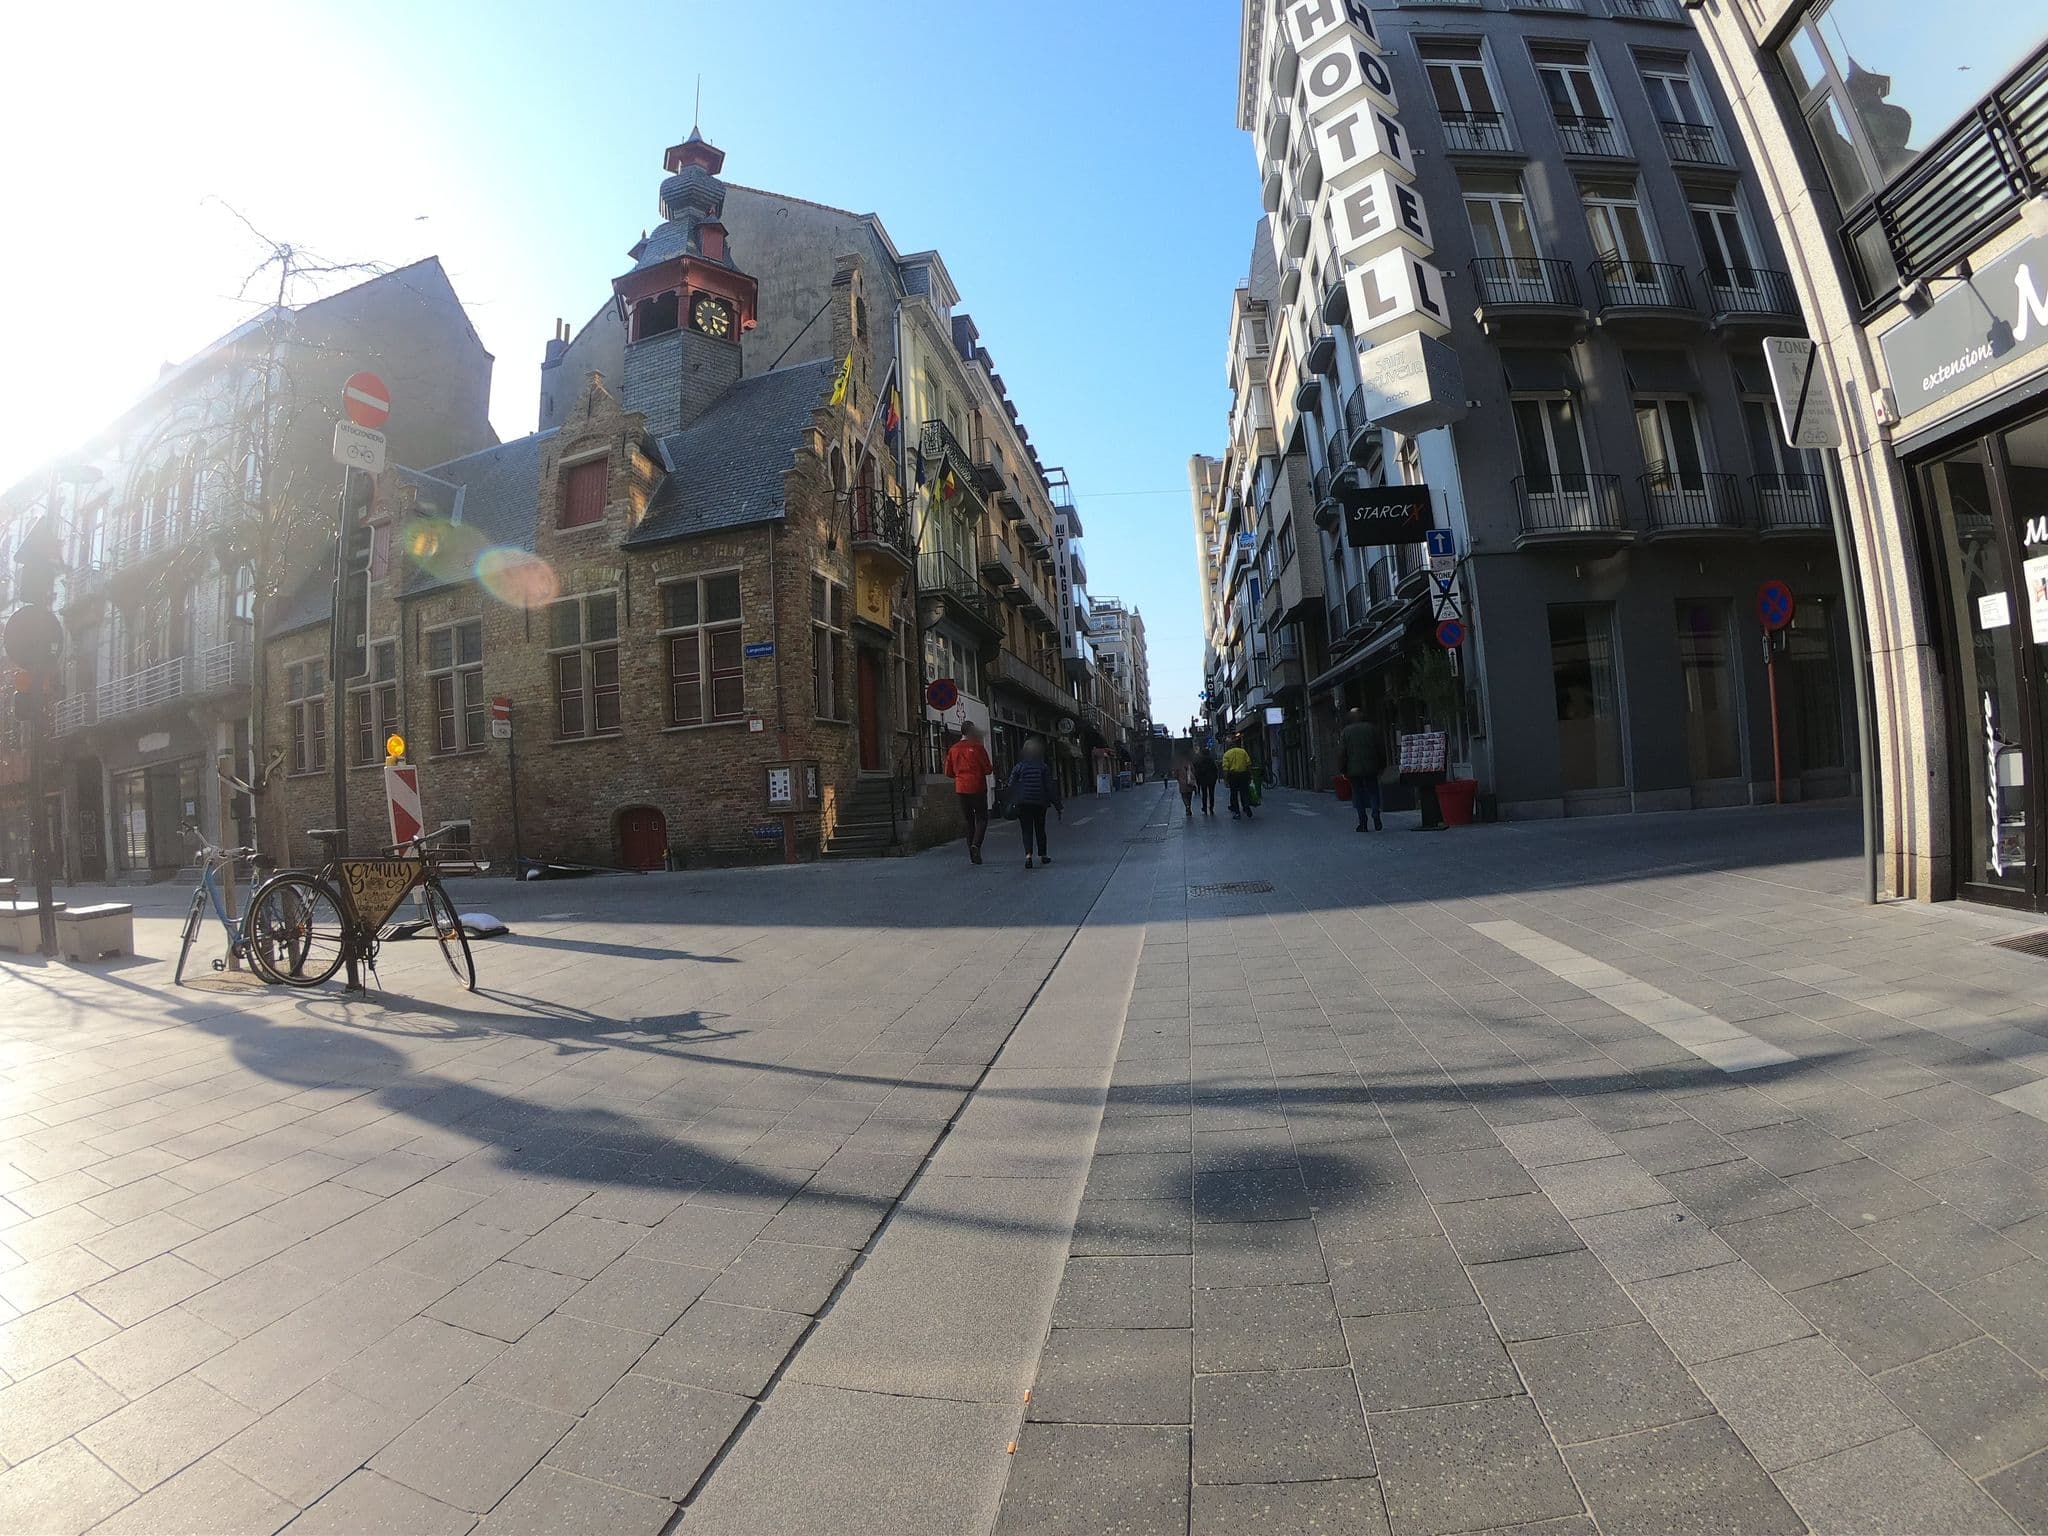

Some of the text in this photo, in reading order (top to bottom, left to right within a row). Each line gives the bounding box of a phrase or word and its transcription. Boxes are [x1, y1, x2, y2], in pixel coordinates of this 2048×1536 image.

[1294, 0, 1398, 321] HOTEL
[1345, 0, 1441, 318] HOTEL
[1776, 340, 1811, 354] ZONE
[1922, 340, 1994, 391] extensions
[1055, 524, 1065, 534] AU
[1057, 538, 1072, 649] PINGOUIN
